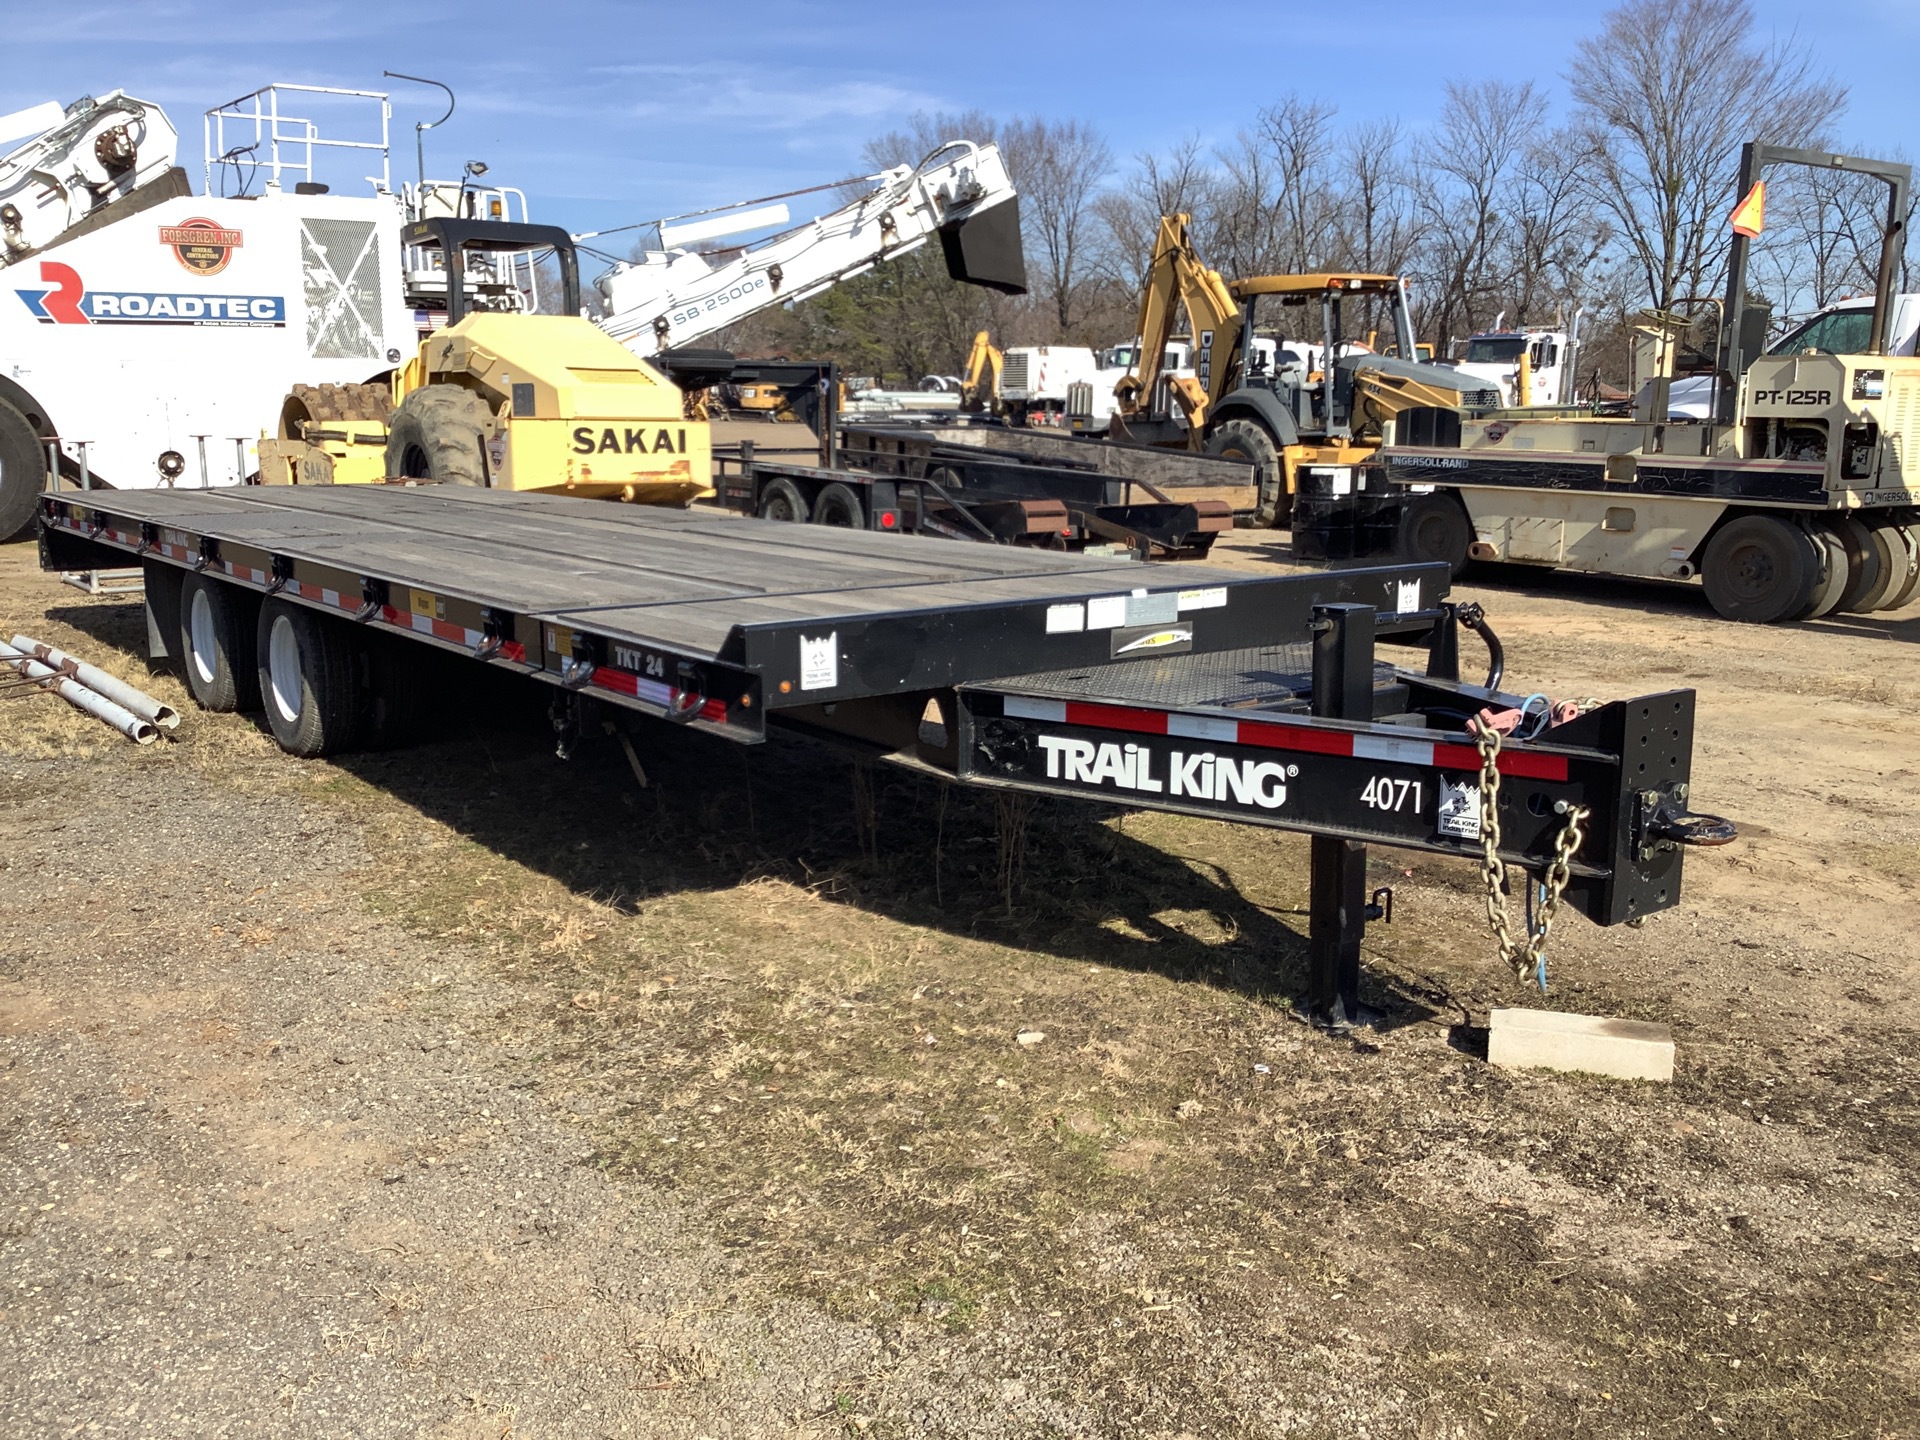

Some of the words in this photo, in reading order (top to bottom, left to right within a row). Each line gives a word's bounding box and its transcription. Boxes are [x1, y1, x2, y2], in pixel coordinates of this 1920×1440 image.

[92, 294, 276, 319] ROADTEC
[1754, 390, 1831, 405] PT-125R
[572, 427, 686, 455] SAKAI
[1392, 456, 1469, 469] INGERSOLL-RAND
[615, 645, 641, 671] TKT
[646, 654, 664, 678] 24
[1360, 775, 1422, 814] 4071
